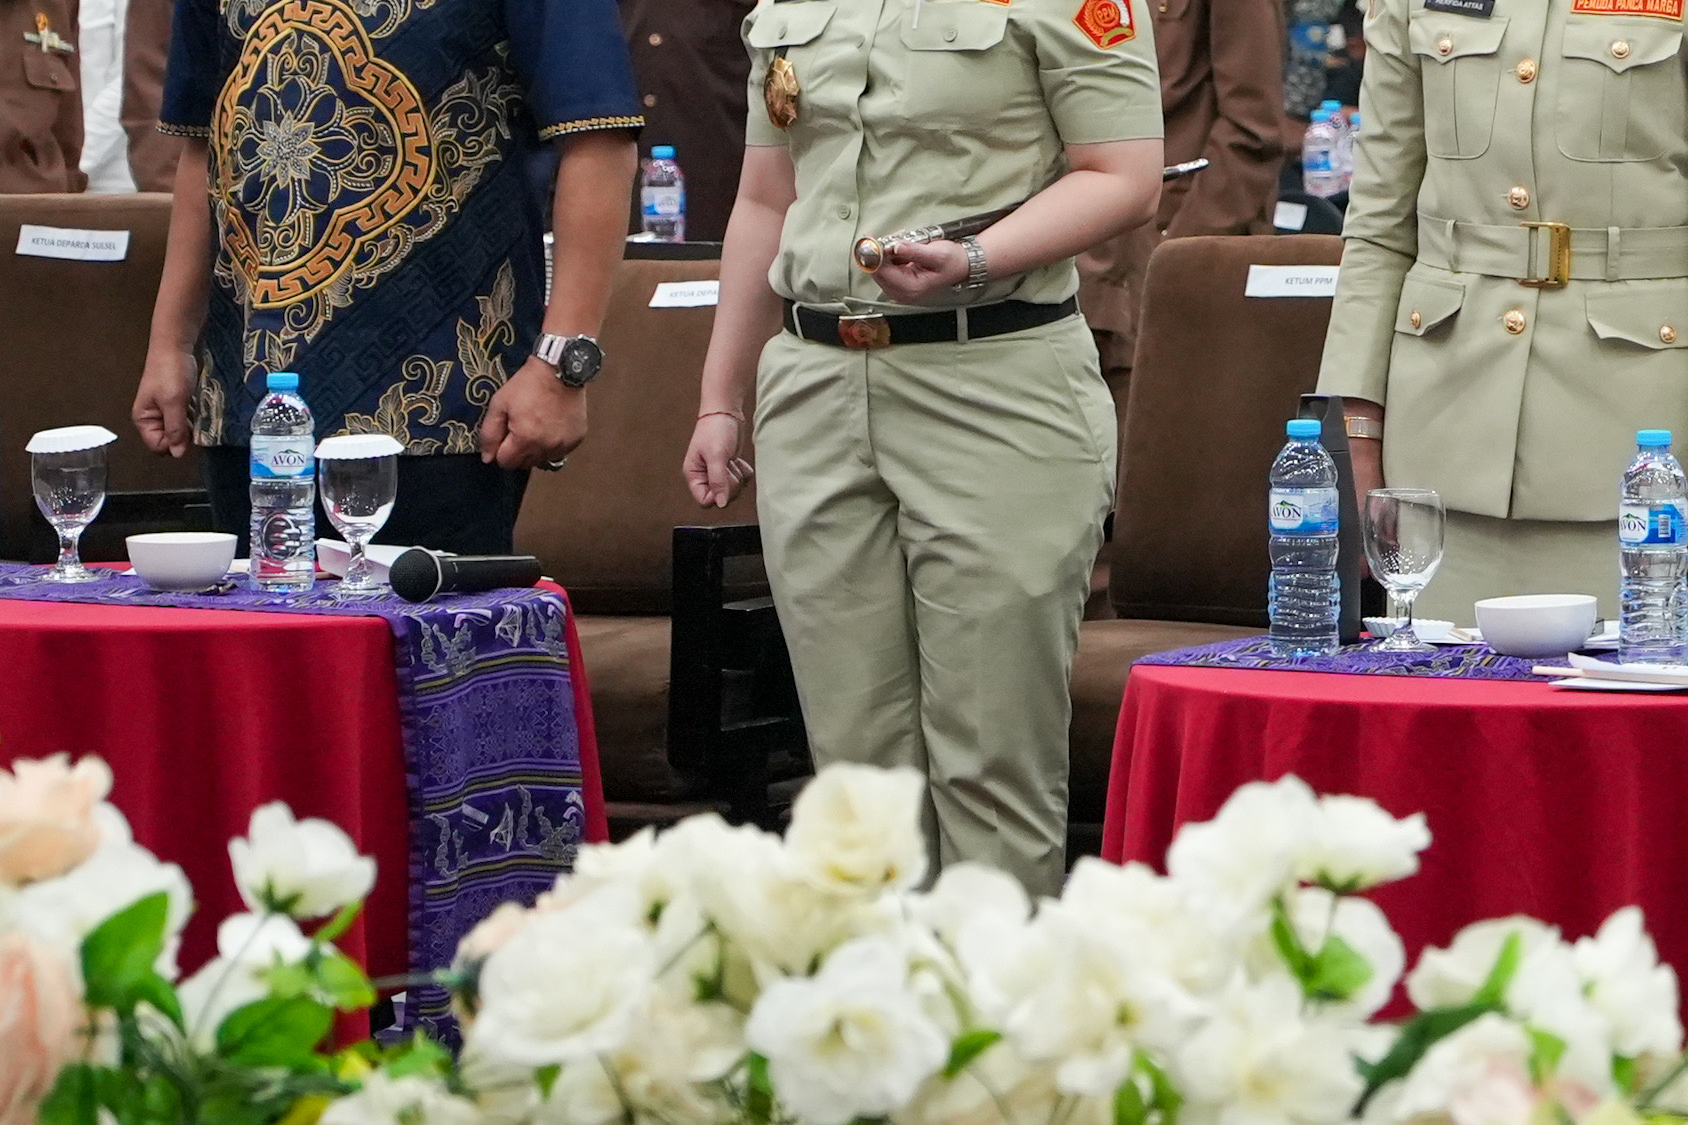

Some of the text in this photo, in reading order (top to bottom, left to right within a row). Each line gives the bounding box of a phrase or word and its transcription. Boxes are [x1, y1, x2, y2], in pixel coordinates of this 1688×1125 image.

[31, 237, 55, 247] KETUA
[1285, 277, 1334, 285] KETUM PPM
[271, 454, 305, 466] AVON
